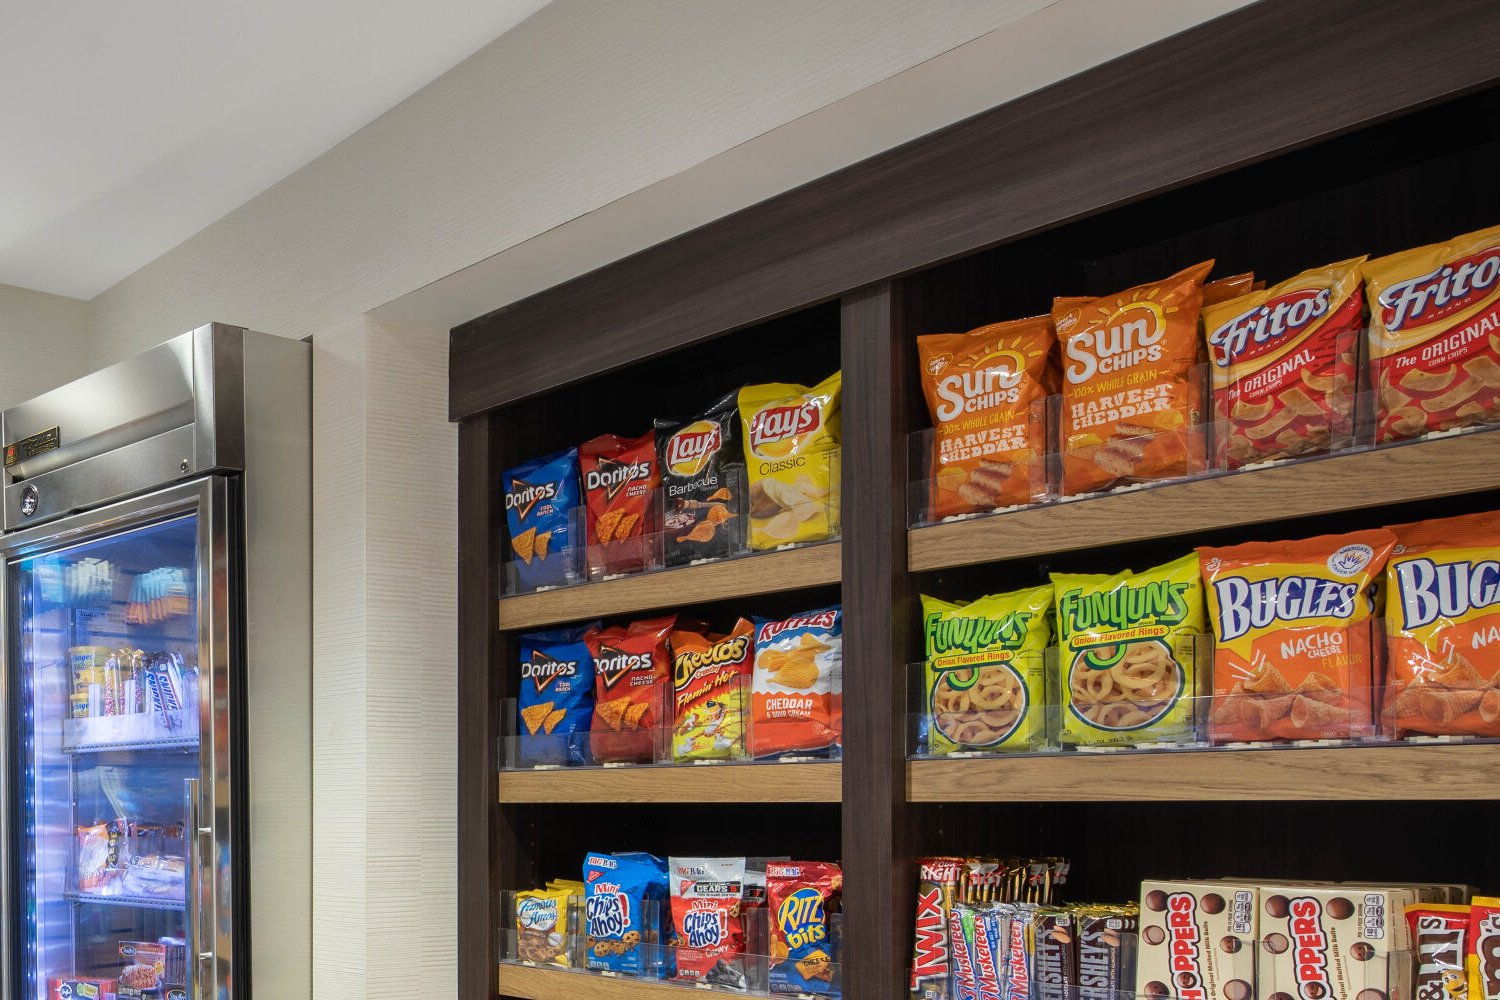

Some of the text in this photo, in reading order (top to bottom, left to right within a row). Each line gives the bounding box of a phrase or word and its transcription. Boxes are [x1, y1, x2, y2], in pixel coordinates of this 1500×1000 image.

[1378, 255, 1500, 332] Frito
[1209, 288, 1332, 367] Fritos
[1396, 311, 1500, 368] The ORIGINAL
[1066, 317, 1166, 384] Sun
[1099, 345, 1162, 374] CHIPS
[1428, 346, 1468, 367] CORN CHIPS
[1096, 377, 1124, 393] WHOLE
[1127, 370, 1157, 386] GRAIN
[1244, 349, 1315, 392] ORIGINAL
[936, 364, 1024, 422] Sun
[964, 387, 1020, 414] CHIPS
[1071, 384, 1172, 420] HARVEST
[754, 402, 817, 445] Lay's
[962, 416, 987, 431] WHOLE
[990, 410, 1015, 425] GRAIN
[1072, 397, 1171, 431] CHEDDAR
[939, 438, 1027, 464] CHEDDAR
[940, 425, 1026, 453] HARVEST
[588, 462, 649, 490] Doritos
[759, 456, 805, 476] Classic
[506, 483, 555, 510] Doritos
[670, 476, 717, 496] Barbecue
[1393, 558, 1500, 630] BUG
[1213, 576, 1358, 642] BUGLES
[1060, 580, 1189, 670] FUNYUNS
[1074, 636, 1097, 646] Onion
[1099, 630, 1137, 641] Flavored
[1139, 626, 1165, 636] Rings
[926, 610, 1032, 691] FUNYUNS
[1281, 632, 1343, 659] NACHO
[1308, 645, 1342, 659] CHEESE
[522, 662, 577, 678] Doritos
[675, 636, 746, 686] Cheetos
[938, 657, 955, 667] Onion
[957, 654, 985, 664] Flavored
[987, 651, 1010, 661] Rings
[1322, 654, 1362, 669] FLAVOR
[695, 665, 720, 679] Crunchy
[715, 670, 738, 686] Hot
[766, 698, 813, 709] CHEDDAR
[589, 857, 602, 865] BIG
[921, 865, 961, 880] RIGHT
[595, 884, 620, 894] Mini
[518, 899, 557, 917] Famous
[586, 896, 619, 920] Chips
[692, 900, 718, 910] Mini
[780, 896, 824, 931] RITZ
[527, 912, 557, 927] Amos
[684, 912, 718, 933] Chips
[787, 924, 826, 950] bits
[911, 888, 948, 989] TWIX
[1330, 926, 1338, 942] Balls
[804, 956, 830, 966] CHEESE
[951, 911, 974, 987] Musketeers
[975, 916, 998, 993] Musketeers
[1333, 944, 1341, 957] Milk
[1335, 958, 1343, 980] Malted
[1207, 974, 1217, 997] Original
